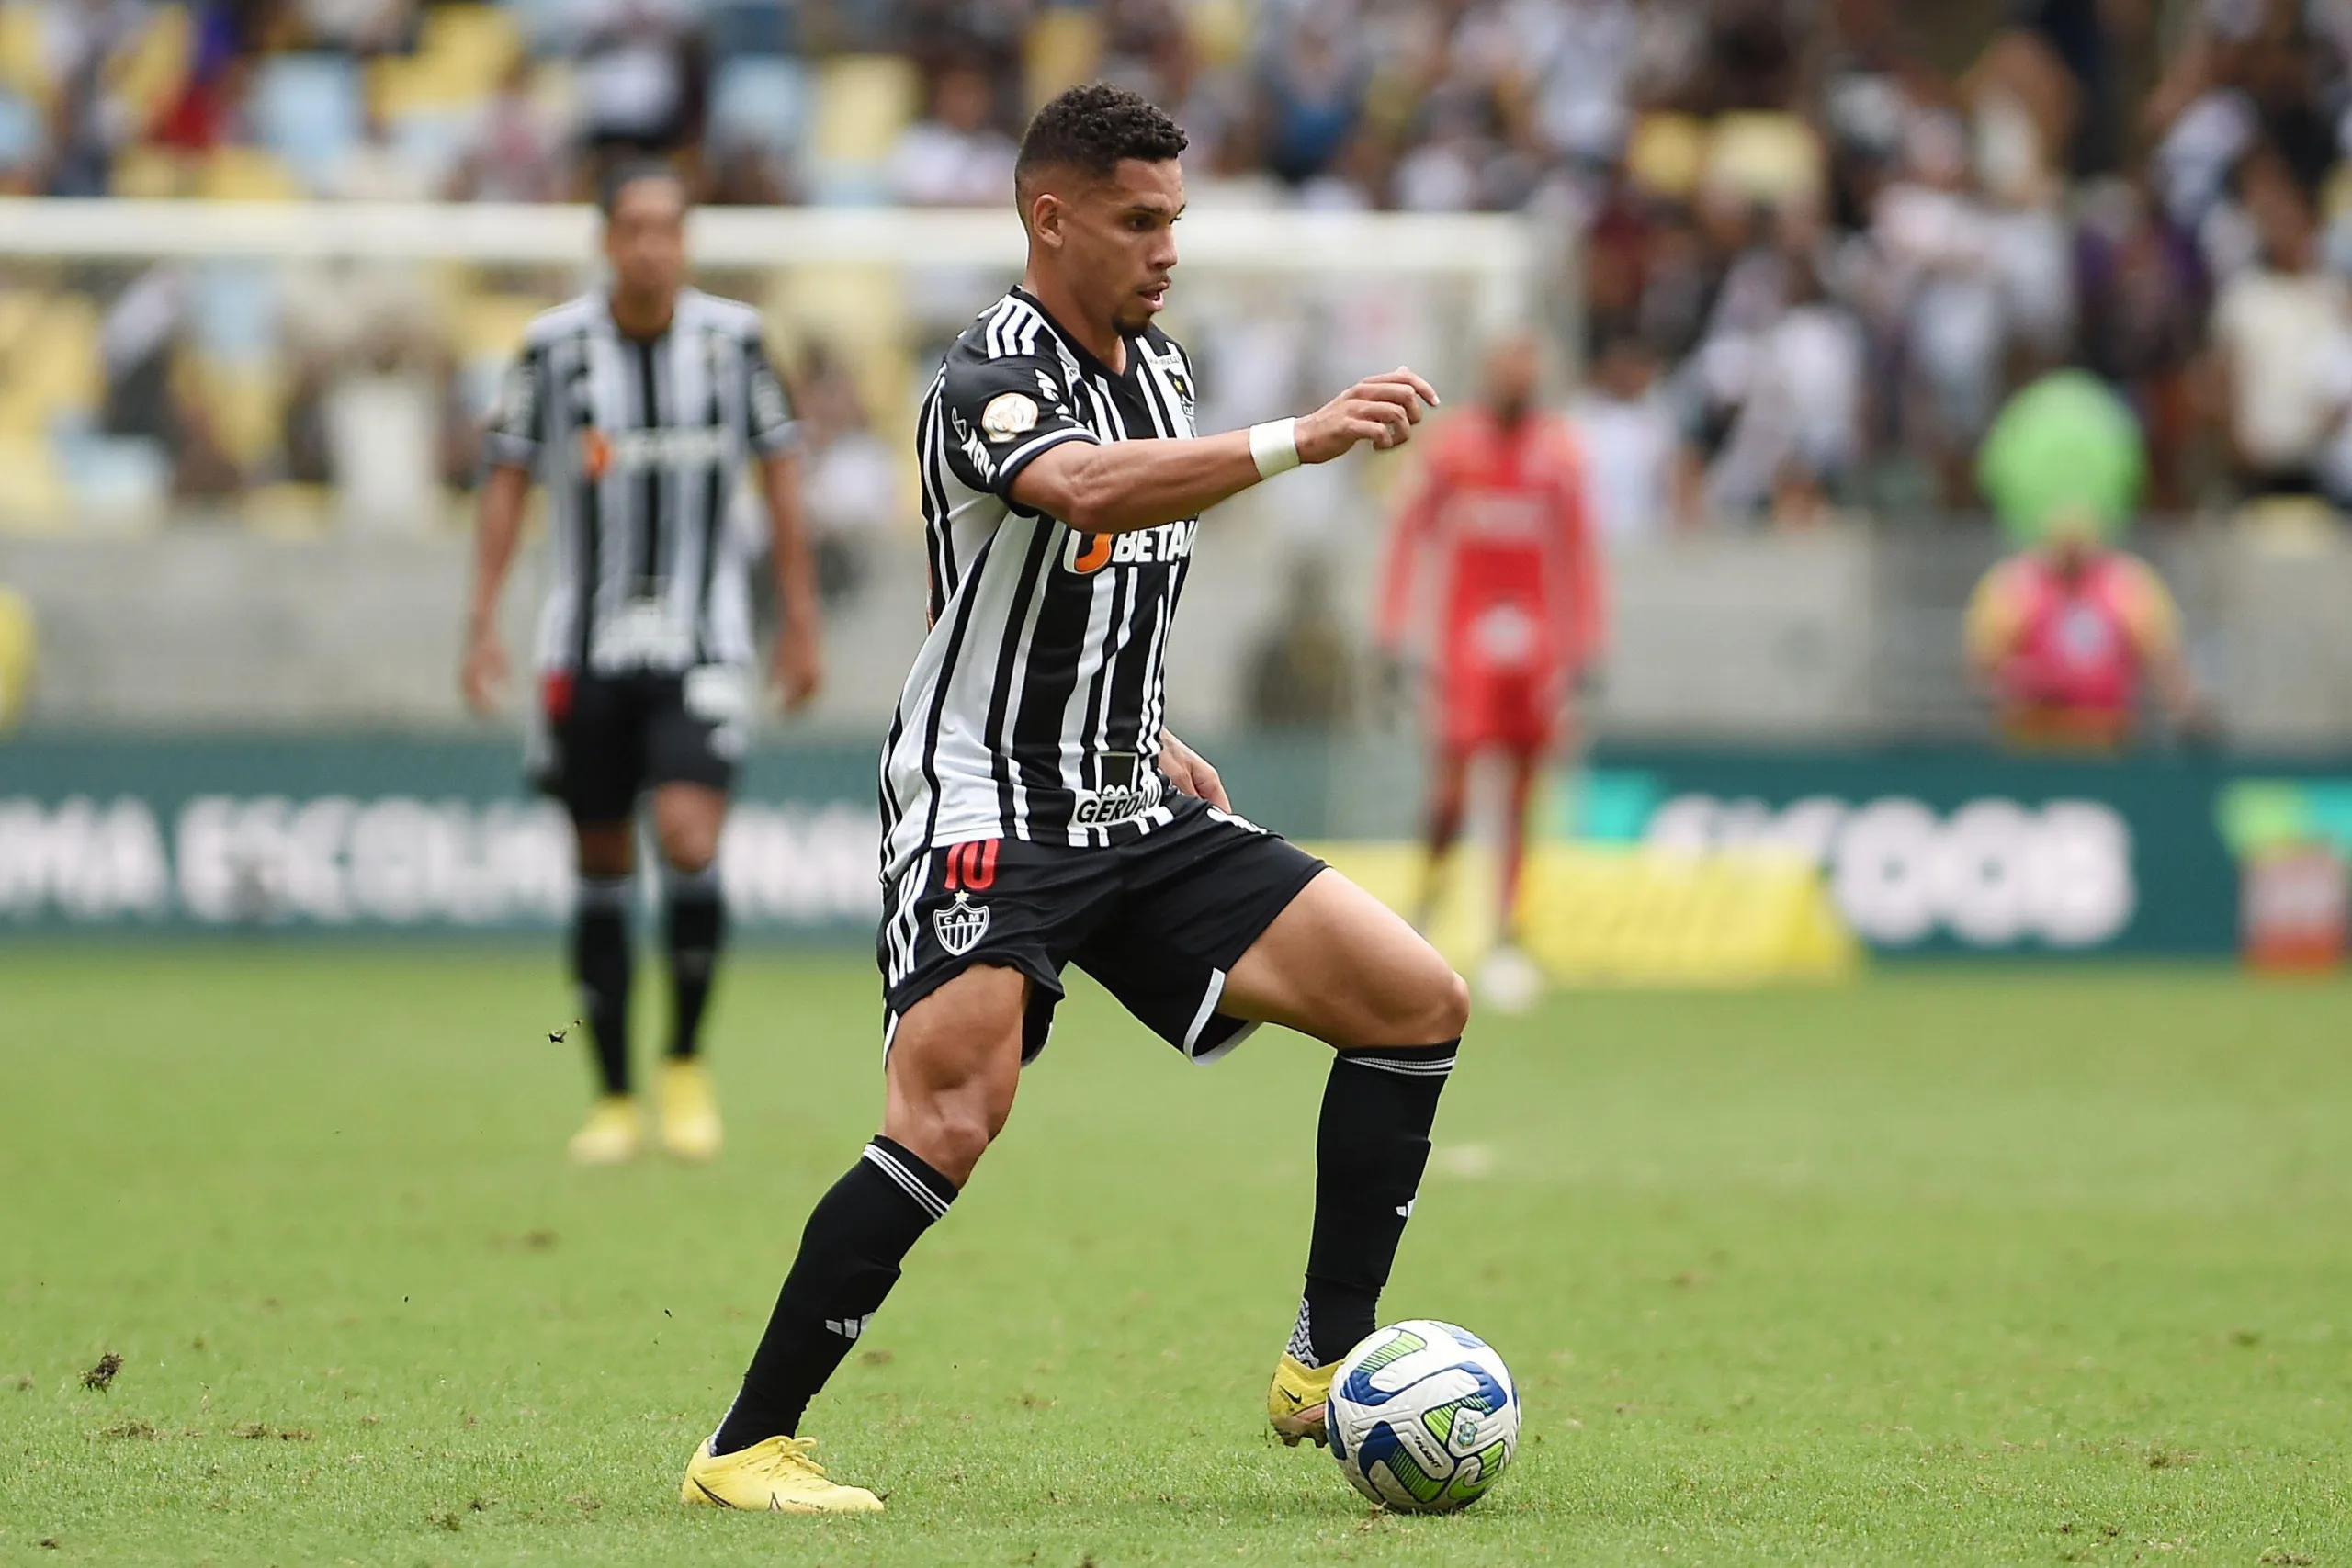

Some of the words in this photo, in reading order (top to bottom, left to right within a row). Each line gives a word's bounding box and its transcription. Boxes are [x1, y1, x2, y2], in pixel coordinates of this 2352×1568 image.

[1076, 782, 1159, 823] GERDAU
[944, 838, 1000, 891] 10
[944, 913, 980, 925] CAM
